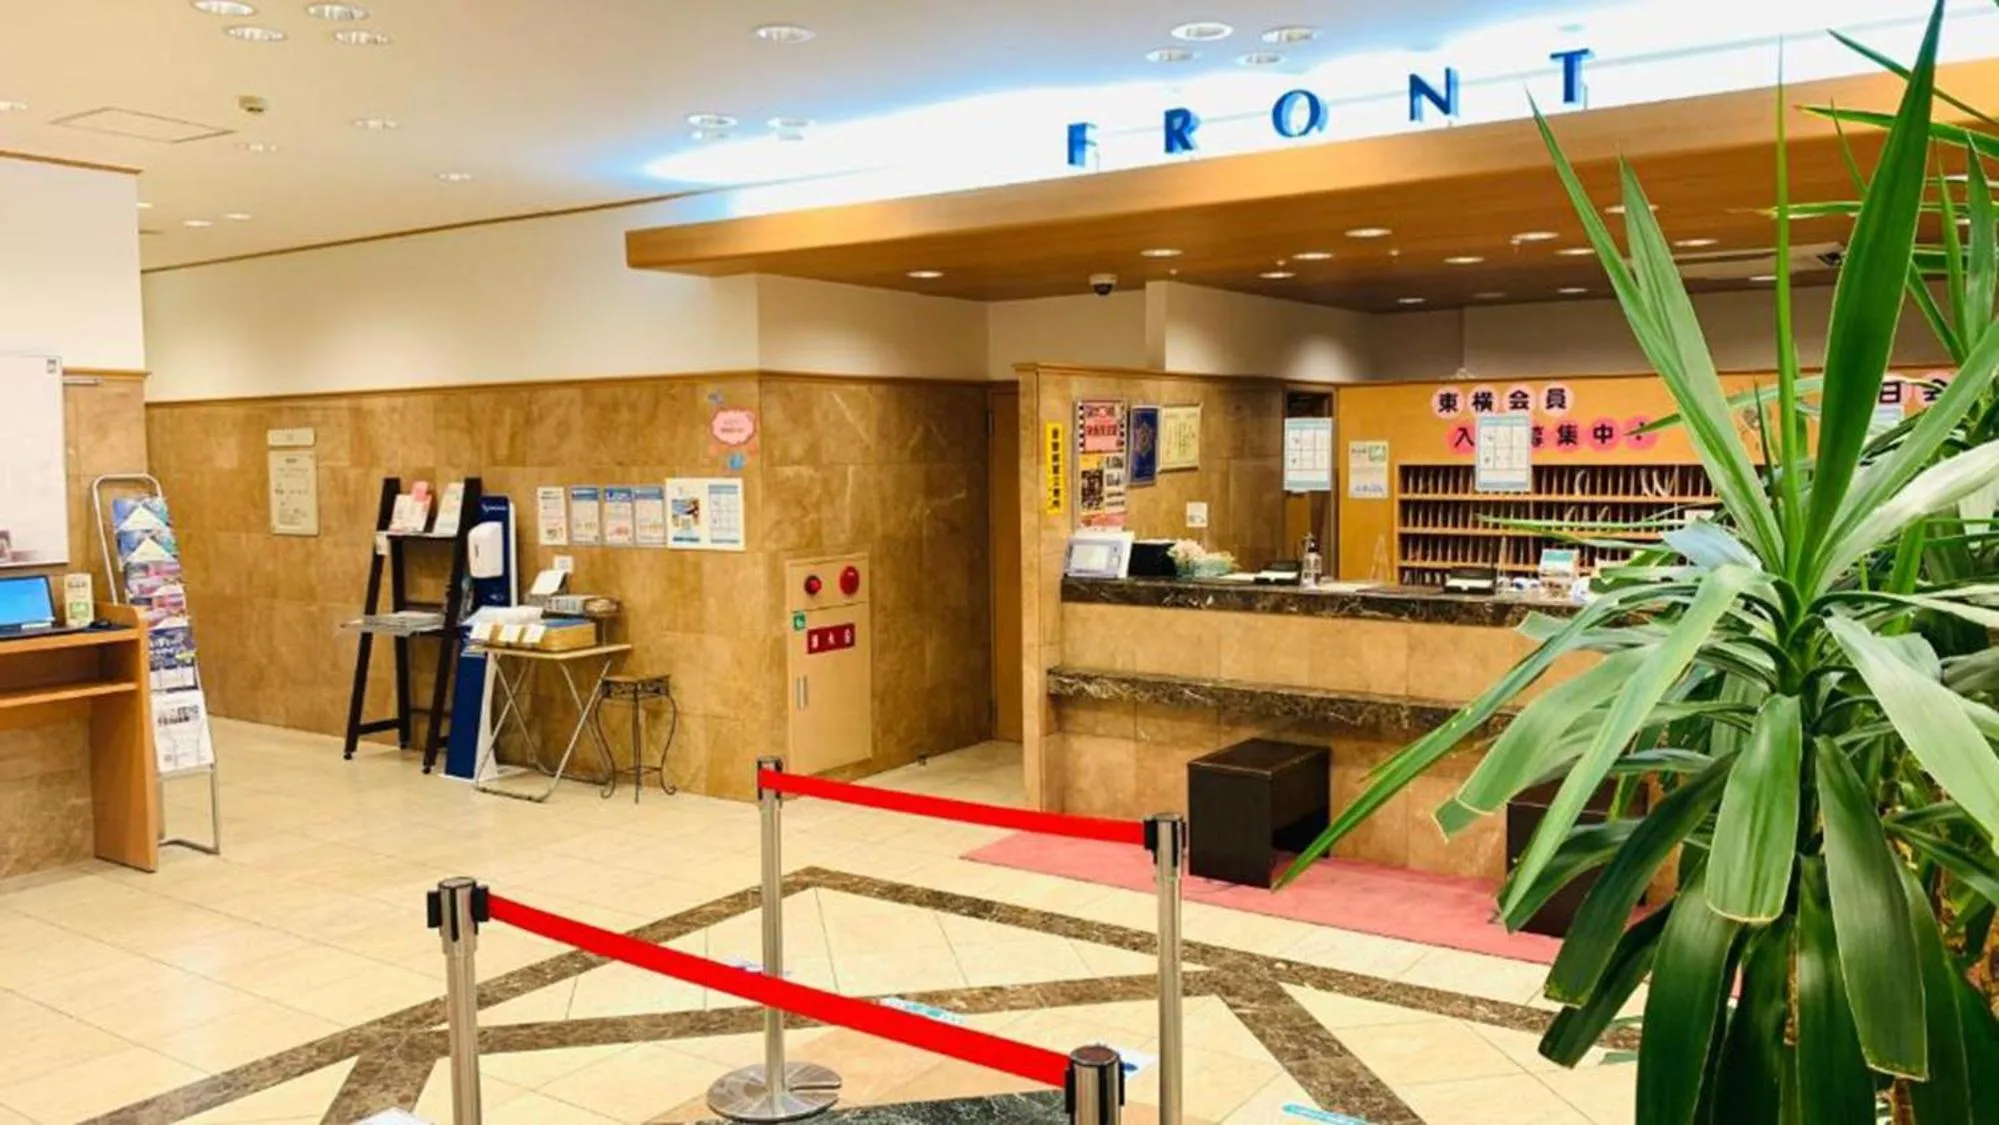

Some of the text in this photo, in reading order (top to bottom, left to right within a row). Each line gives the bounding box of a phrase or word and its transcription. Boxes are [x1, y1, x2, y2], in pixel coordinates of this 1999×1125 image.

[1066, 47, 1593, 167] FRONT
[1438, 387, 1567, 413] 東横会員
